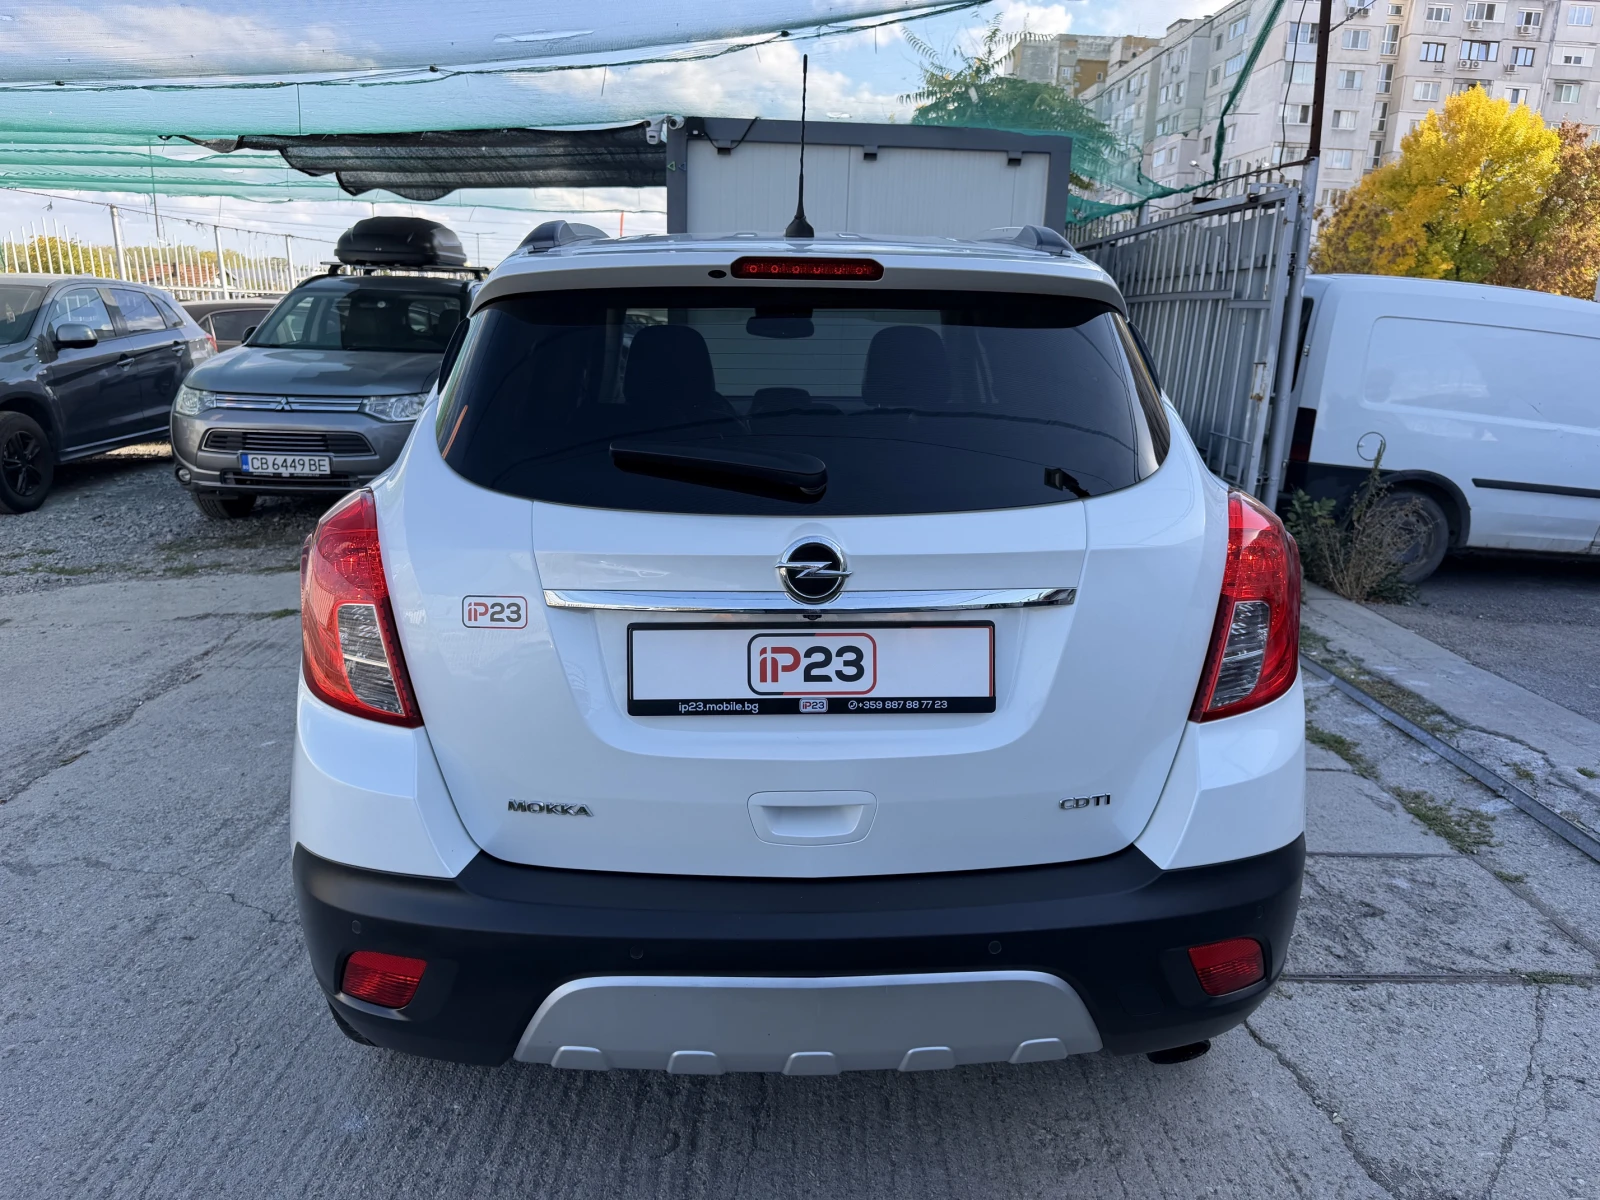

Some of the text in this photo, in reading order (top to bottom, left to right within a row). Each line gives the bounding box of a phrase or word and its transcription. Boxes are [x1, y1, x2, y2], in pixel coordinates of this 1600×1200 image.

[251, 457, 328, 472] CB 6449 BE
[678, 702, 759, 713] ip23.mobile.bg
[858, 700, 948, 709] +359 887 88 77 23
[507, 799, 594, 817] MOKKA
[1059, 792, 1111, 809] CDTI
